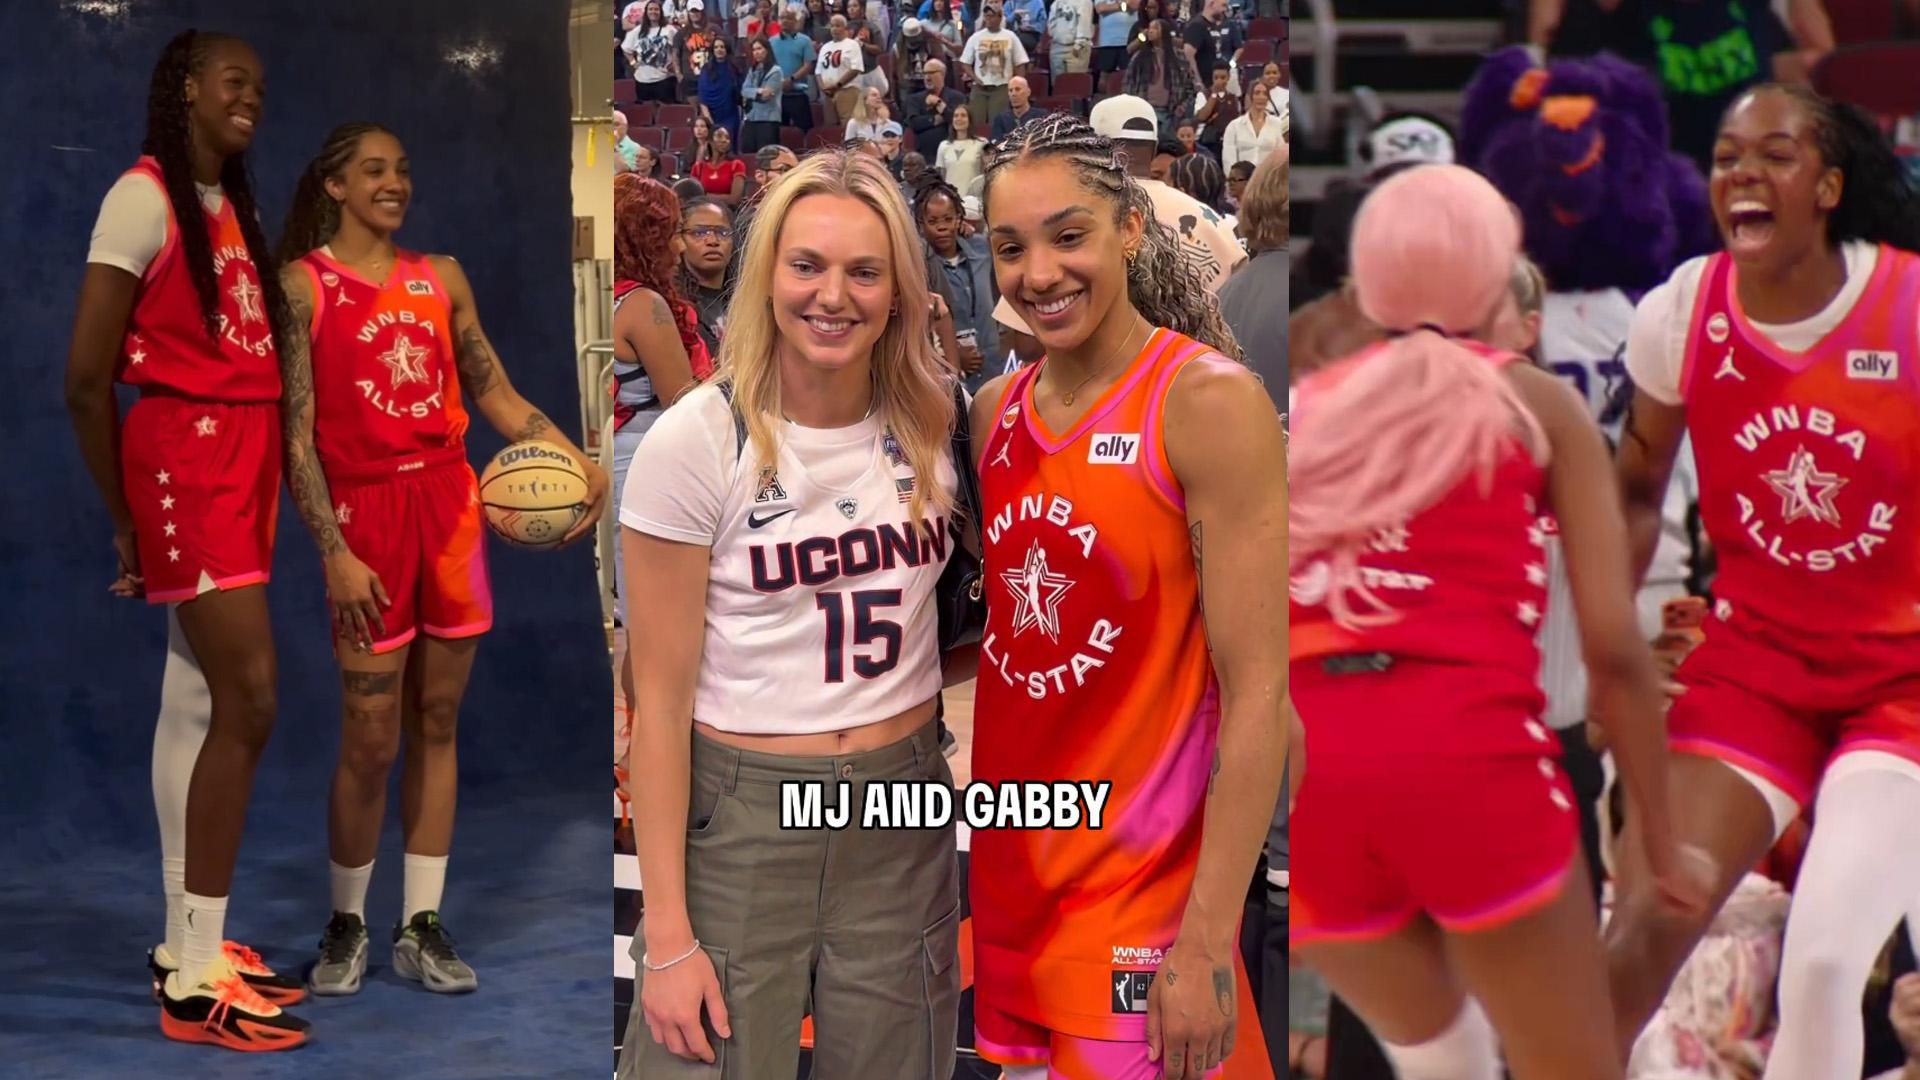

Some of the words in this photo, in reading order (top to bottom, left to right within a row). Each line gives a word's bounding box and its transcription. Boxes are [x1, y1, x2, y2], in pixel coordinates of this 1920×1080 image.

[213, 245, 254, 275] WNB
[409, 281, 429, 293] ally
[356, 310, 434, 343] WNBA
[1853, 354, 1892, 376] ally
[1095, 436, 1135, 461] ally
[1734, 404, 1867, 460] WNBA
[500, 446, 572, 467] Wilson
[987, 493, 1098, 558] WNBA
[1736, 493, 1897, 571] ALL-STAR
[749, 516, 946, 593] UCONN
[815, 588, 903, 683] 15
[983, 606, 1123, 699] LL-STAR
[1112, 946, 1162, 957] WNBA
